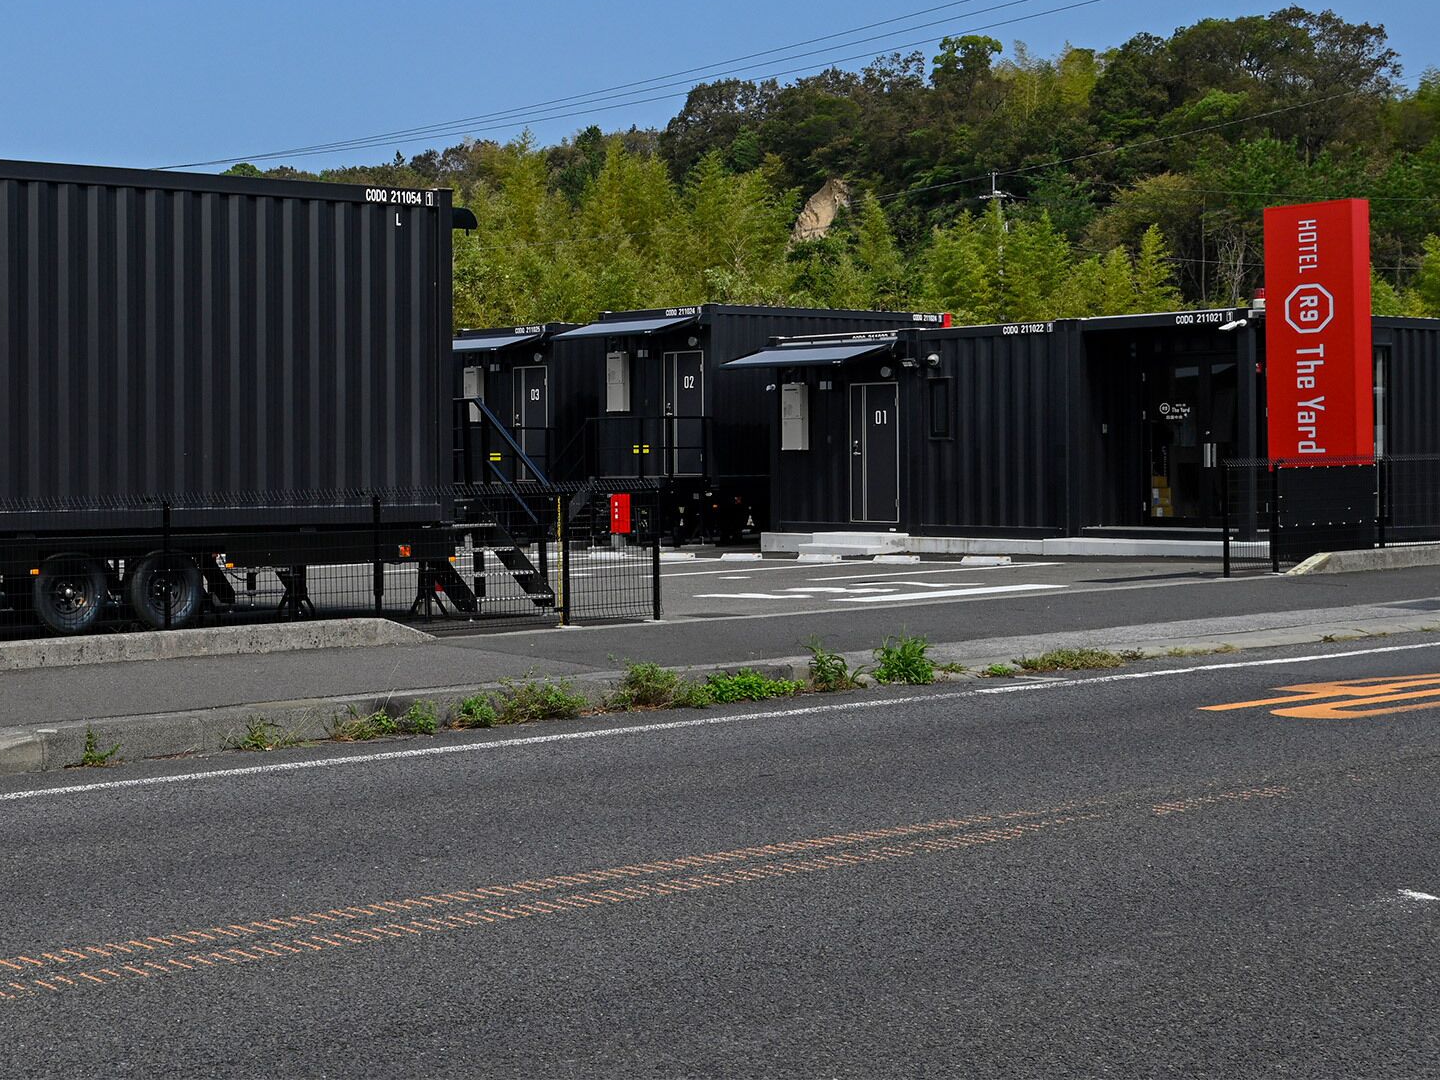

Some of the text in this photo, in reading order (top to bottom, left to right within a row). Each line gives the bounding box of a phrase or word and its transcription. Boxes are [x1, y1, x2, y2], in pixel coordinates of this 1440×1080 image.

[365, 188, 387, 202] CODQ
[390, 190, 422, 205] 211054
[395, 212, 402, 227] L
[1176, 315, 1194, 324] CODQ
[1197, 312, 1223, 323] 211021
[1020, 323, 1045, 334] 211022
[1297, 219, 1326, 454] HOTEL R9 The Yard
[683, 375, 695, 389] 02
[530, 388, 540, 401] 03
[875, 410, 888, 425] 01
